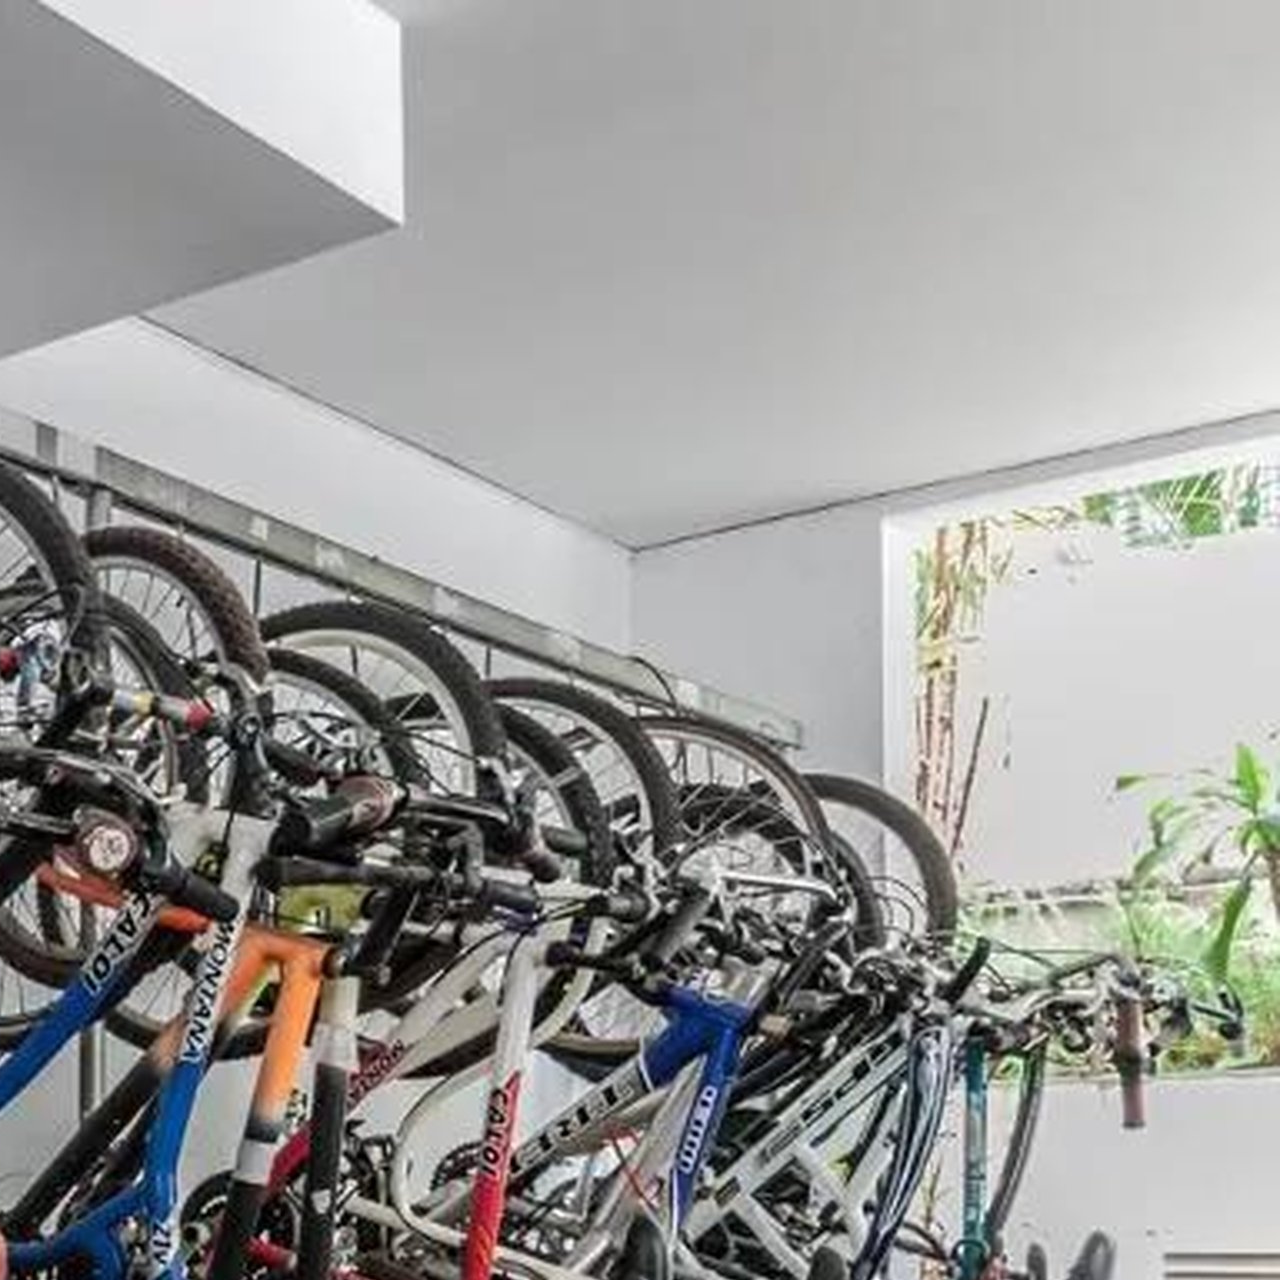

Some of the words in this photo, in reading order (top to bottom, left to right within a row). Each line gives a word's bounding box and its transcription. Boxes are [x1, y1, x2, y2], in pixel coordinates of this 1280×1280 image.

[85, 890, 152, 992] CALOI
[182, 920, 236, 1061] MONTANA
[482, 1088, 509, 1176] CALOI
